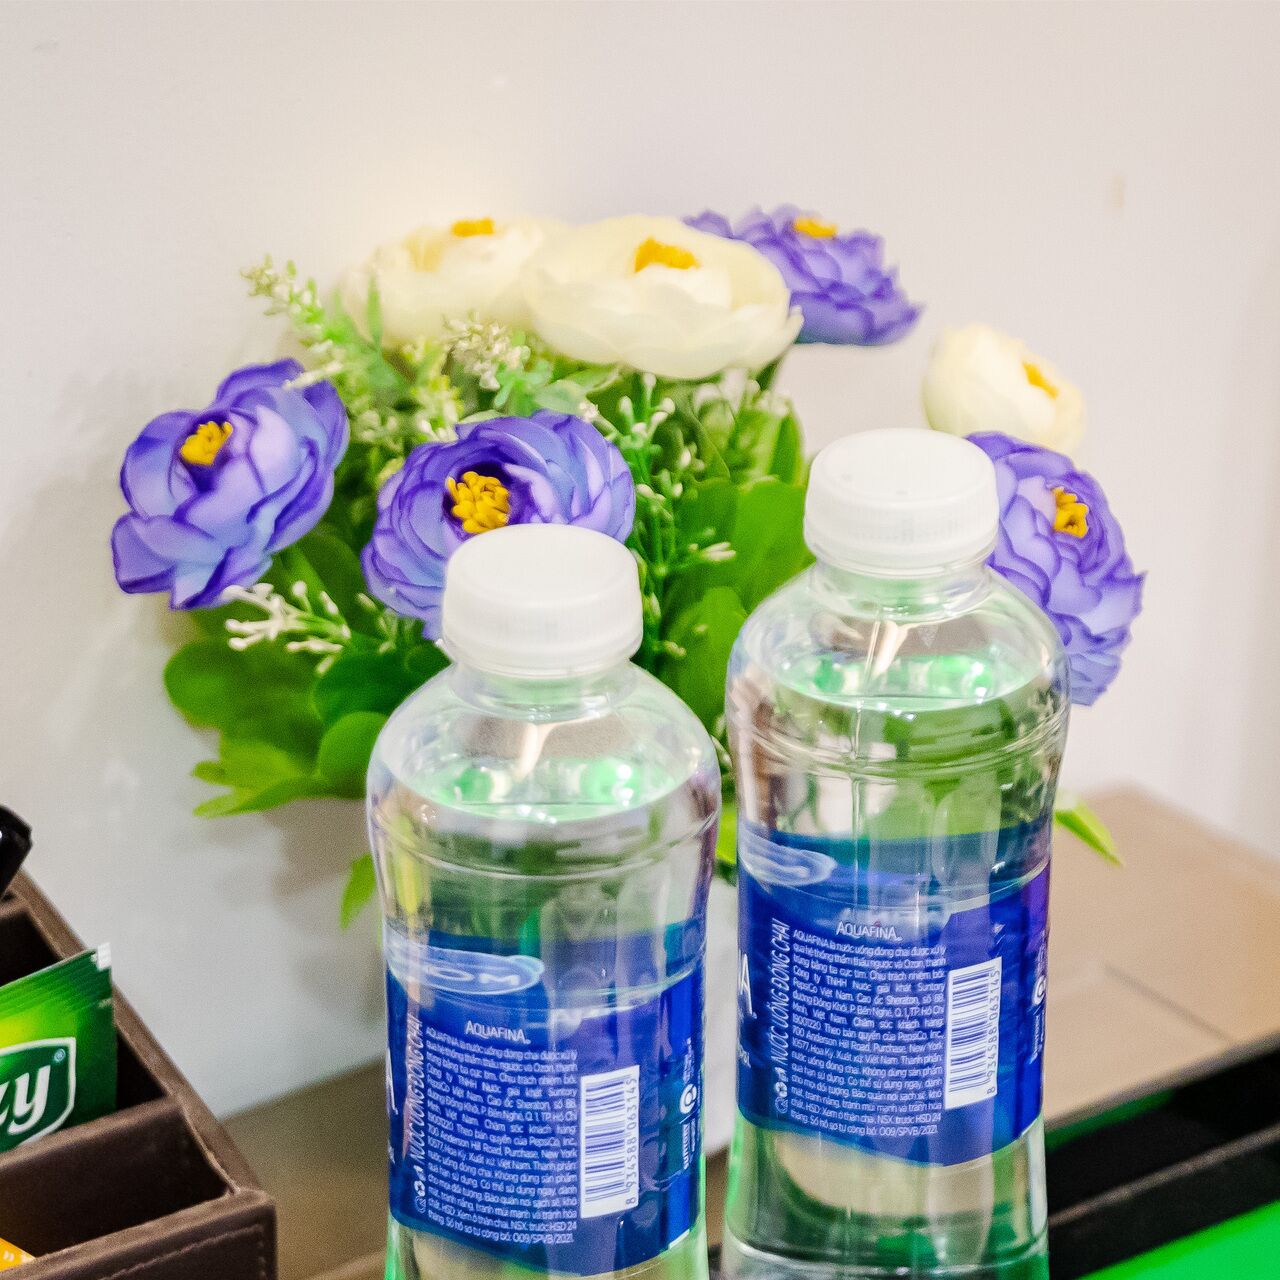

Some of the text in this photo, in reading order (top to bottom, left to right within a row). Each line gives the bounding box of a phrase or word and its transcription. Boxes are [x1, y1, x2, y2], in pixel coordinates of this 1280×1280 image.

[771, 917, 791, 951] CHAI
[836, 921, 898, 941] AQUAFINA
[465, 1020, 527, 1045] AQUAFINA
[986, 970, 1000, 1094] 8 934588 063145
[625, 1078, 637, 1205] 8 934588 063145
